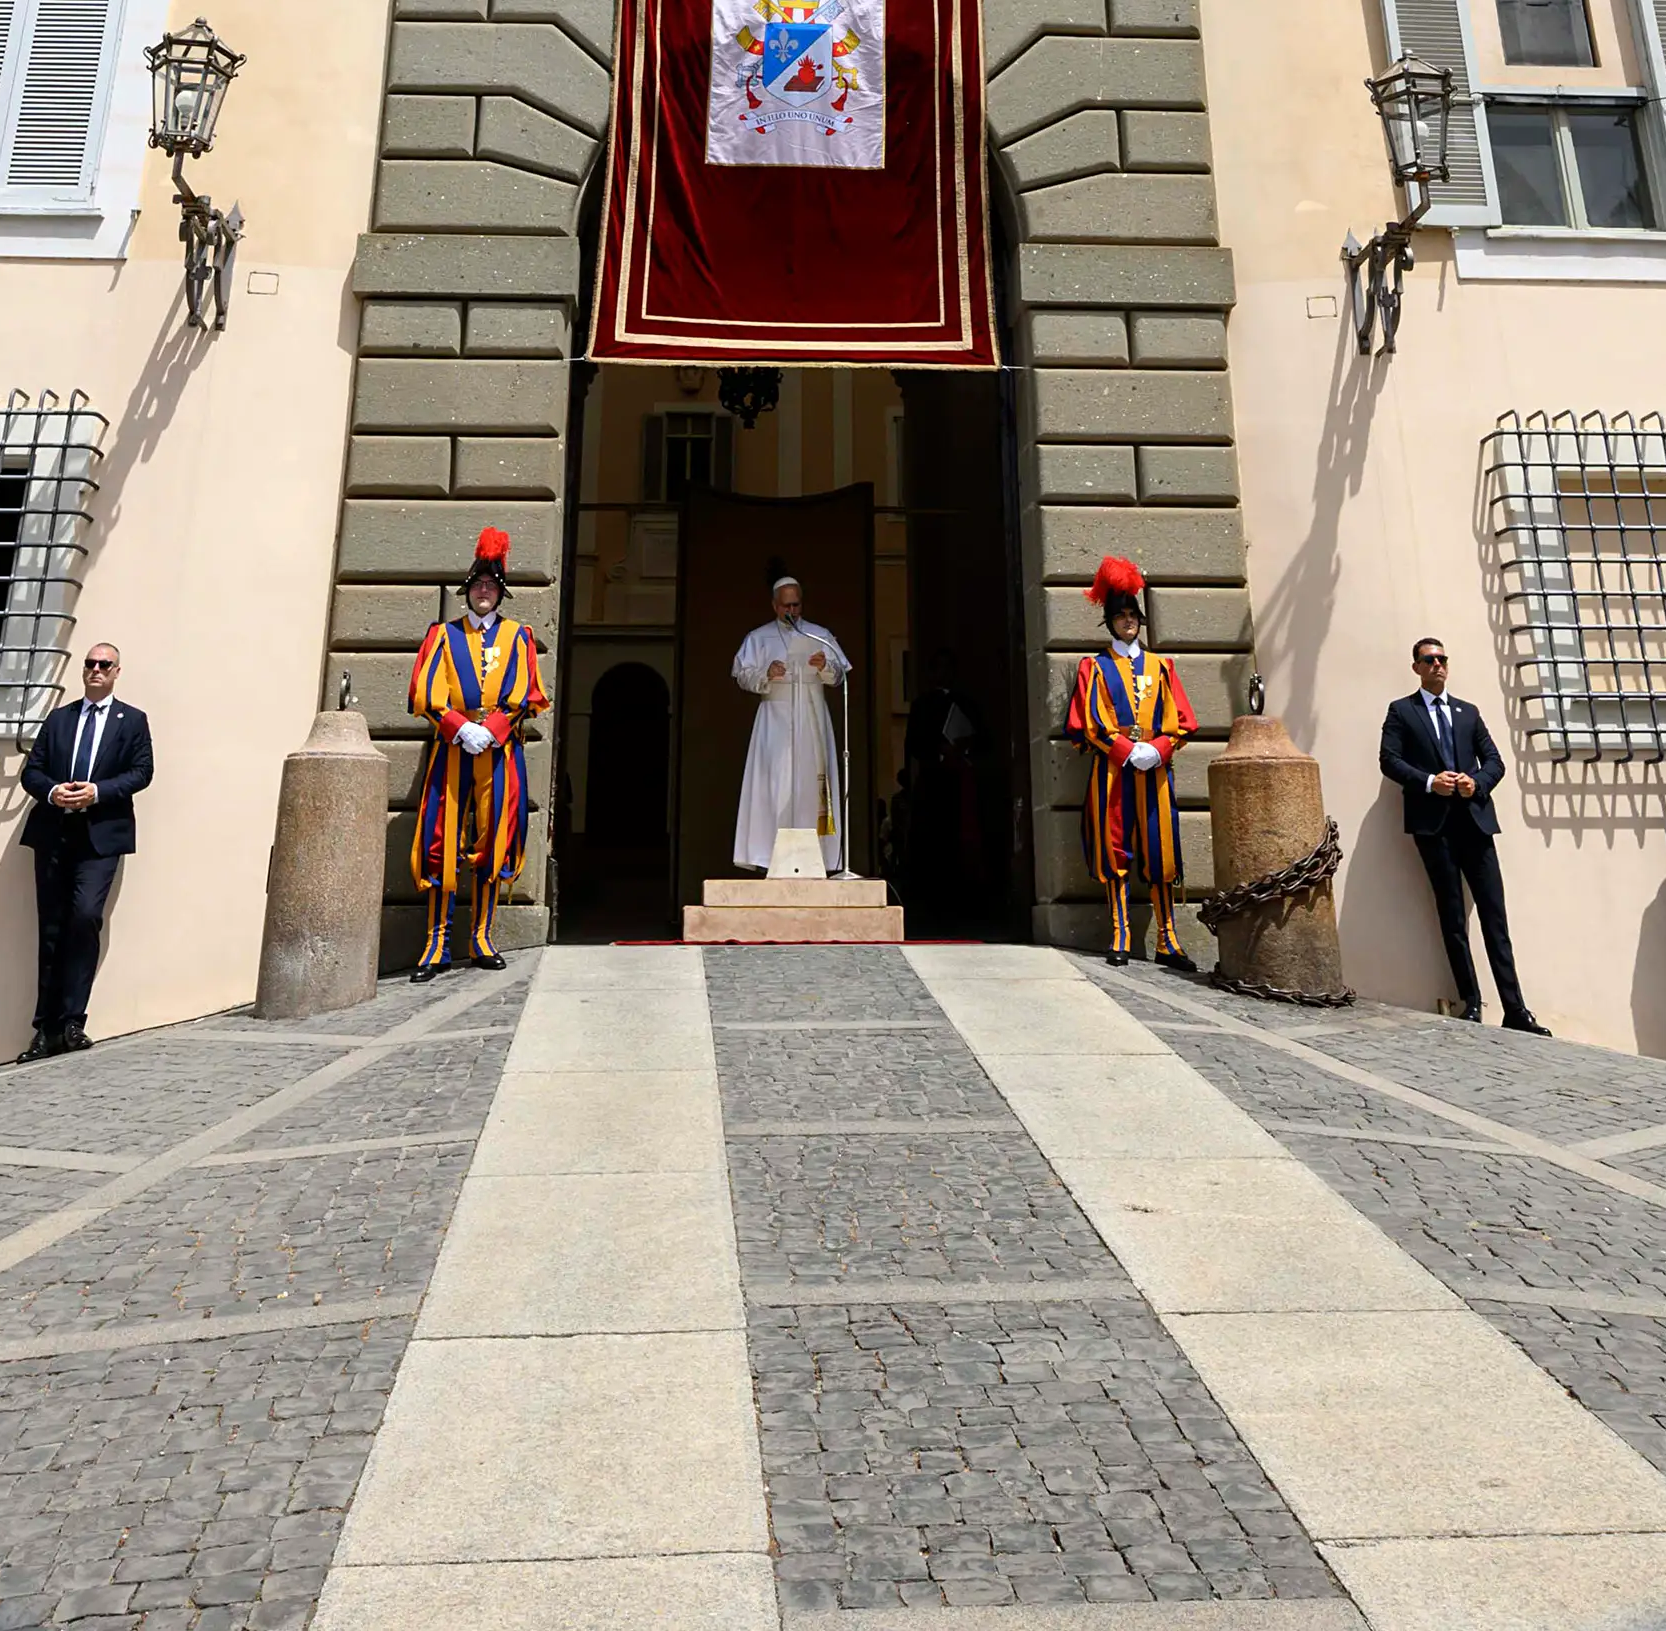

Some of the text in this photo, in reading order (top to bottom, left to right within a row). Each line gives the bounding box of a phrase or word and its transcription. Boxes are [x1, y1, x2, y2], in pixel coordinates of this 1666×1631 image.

[755, 117, 767, 125] IN
[787, 111, 807, 119] UNO
[809, 113, 835, 127] UNUM
